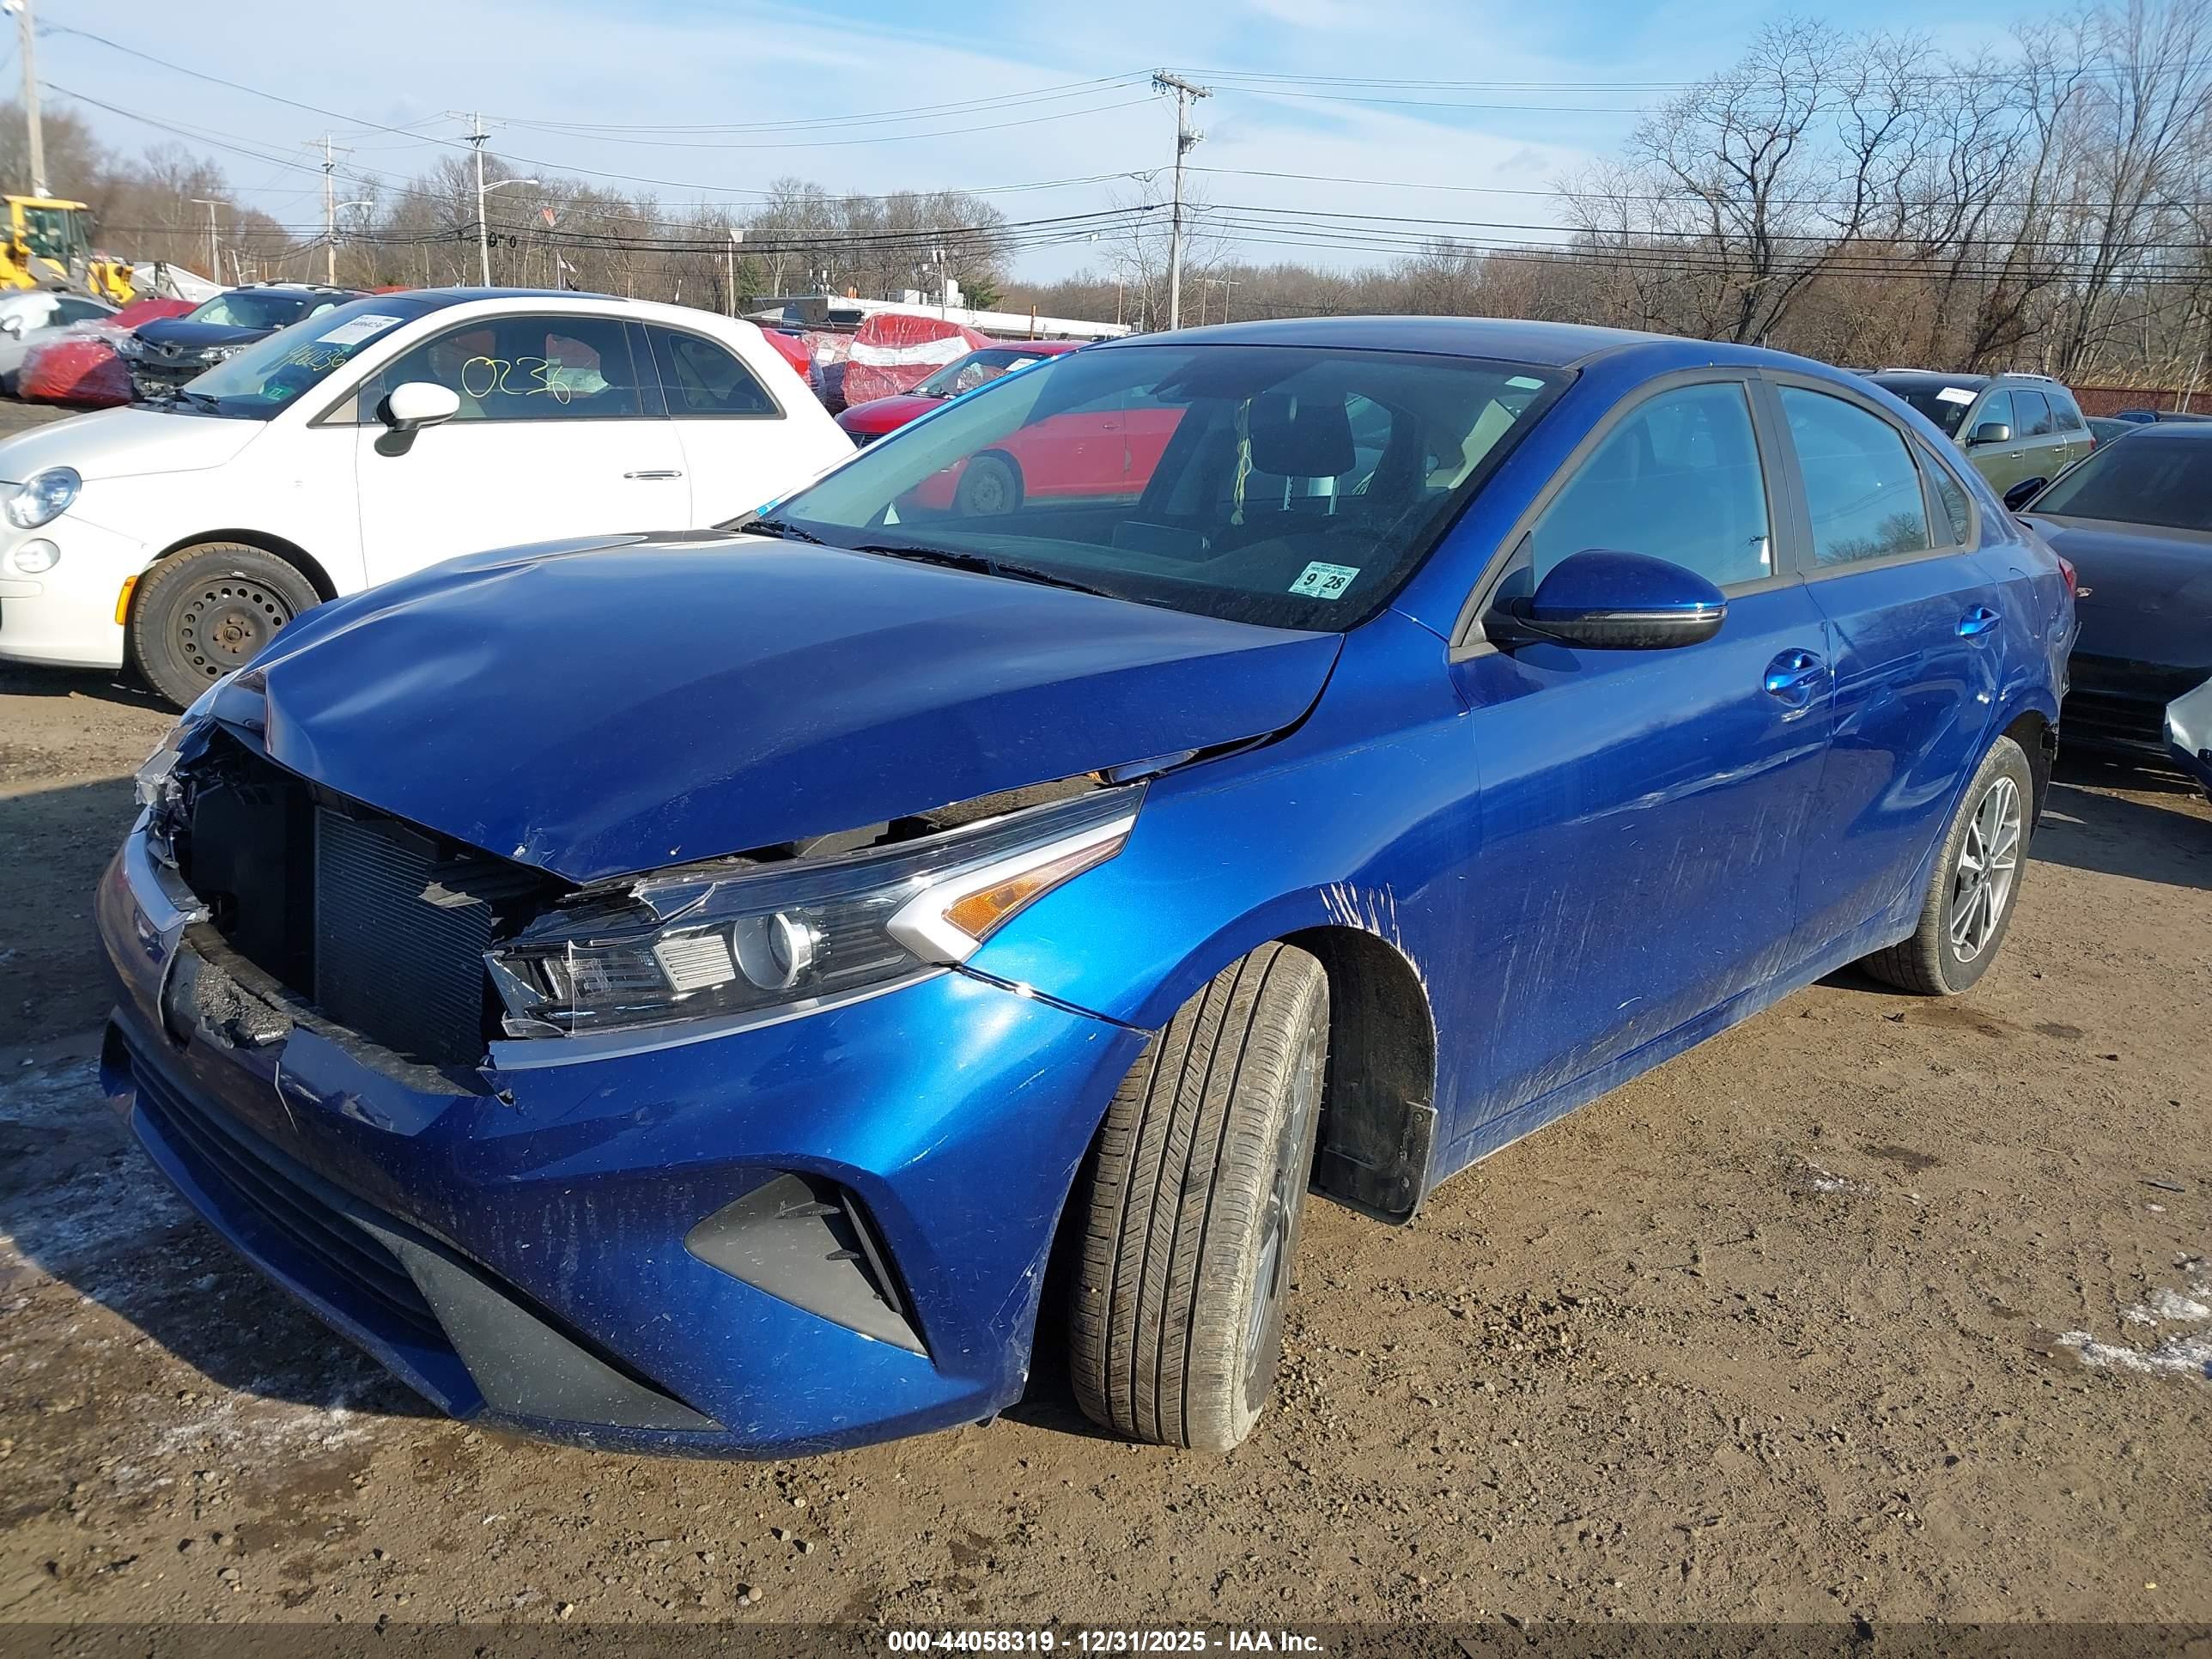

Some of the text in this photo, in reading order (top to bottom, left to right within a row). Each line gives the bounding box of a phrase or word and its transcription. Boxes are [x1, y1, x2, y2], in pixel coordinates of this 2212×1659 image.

[461, 356, 570, 404] 0236
[1304, 573, 1346, 590] 9 28
